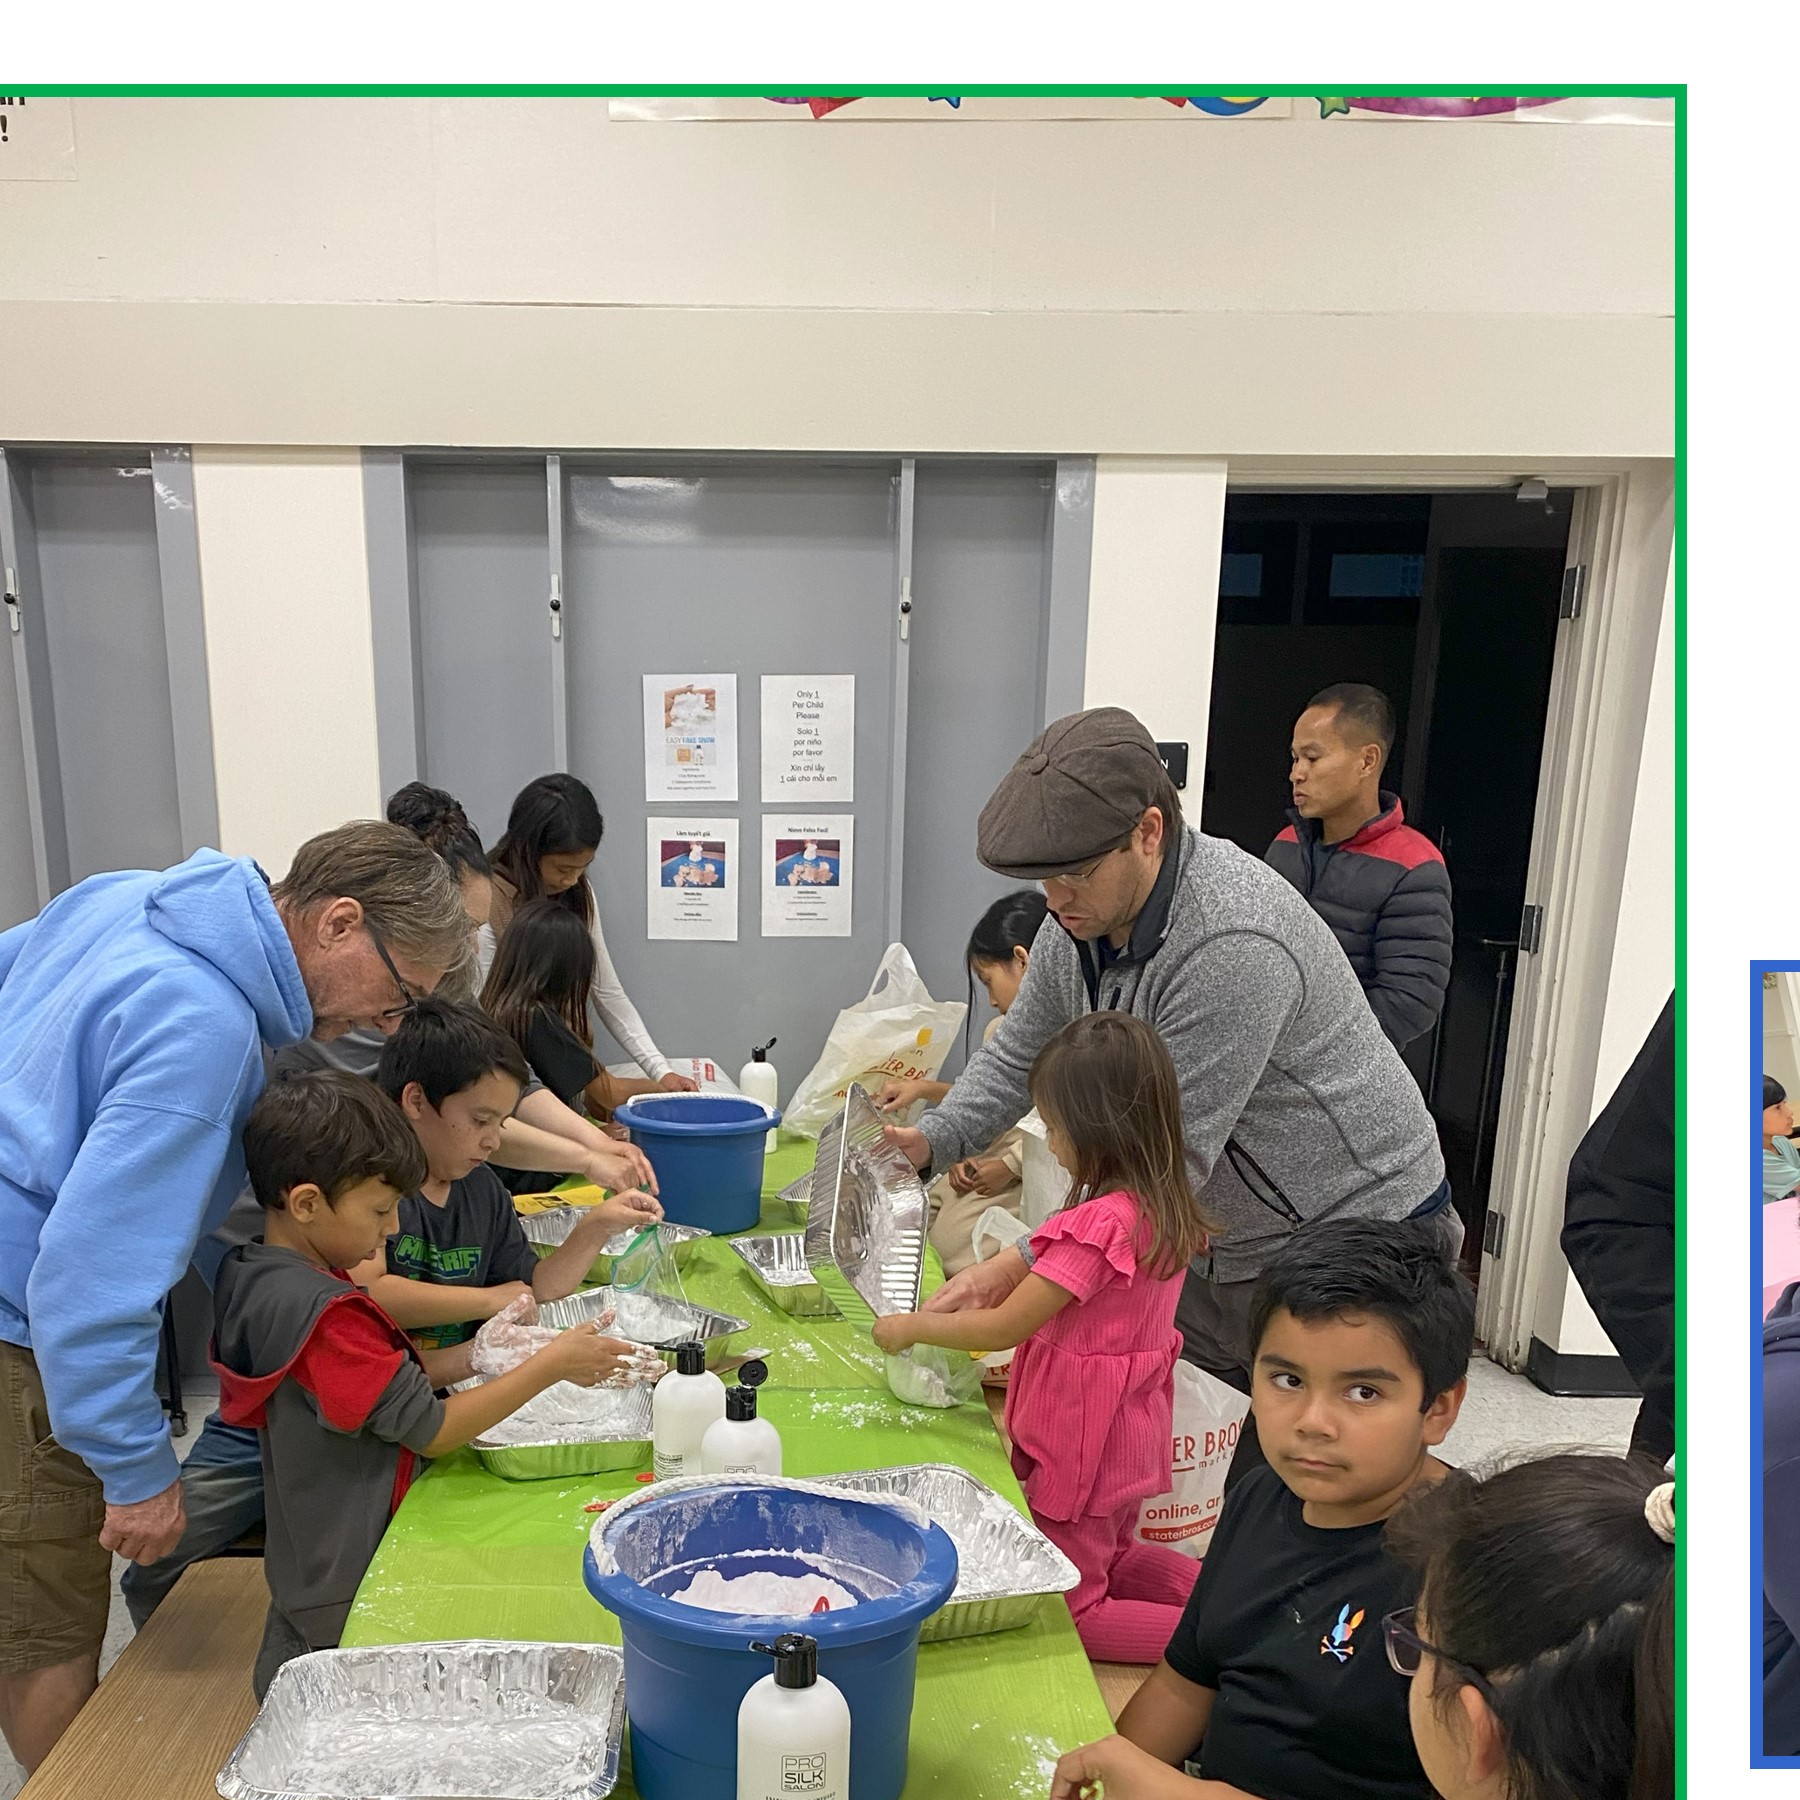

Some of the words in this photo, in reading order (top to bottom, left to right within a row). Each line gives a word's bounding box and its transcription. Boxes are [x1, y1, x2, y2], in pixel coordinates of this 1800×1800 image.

[797, 691, 813, 699] Only
[814, 728, 819, 736] 1
[1146, 1503, 1202, 1520] online,
[785, 1756, 824, 1769] PRO
[784, 1770, 823, 1784] SILK
[784, 1782, 824, 1790] SALON
